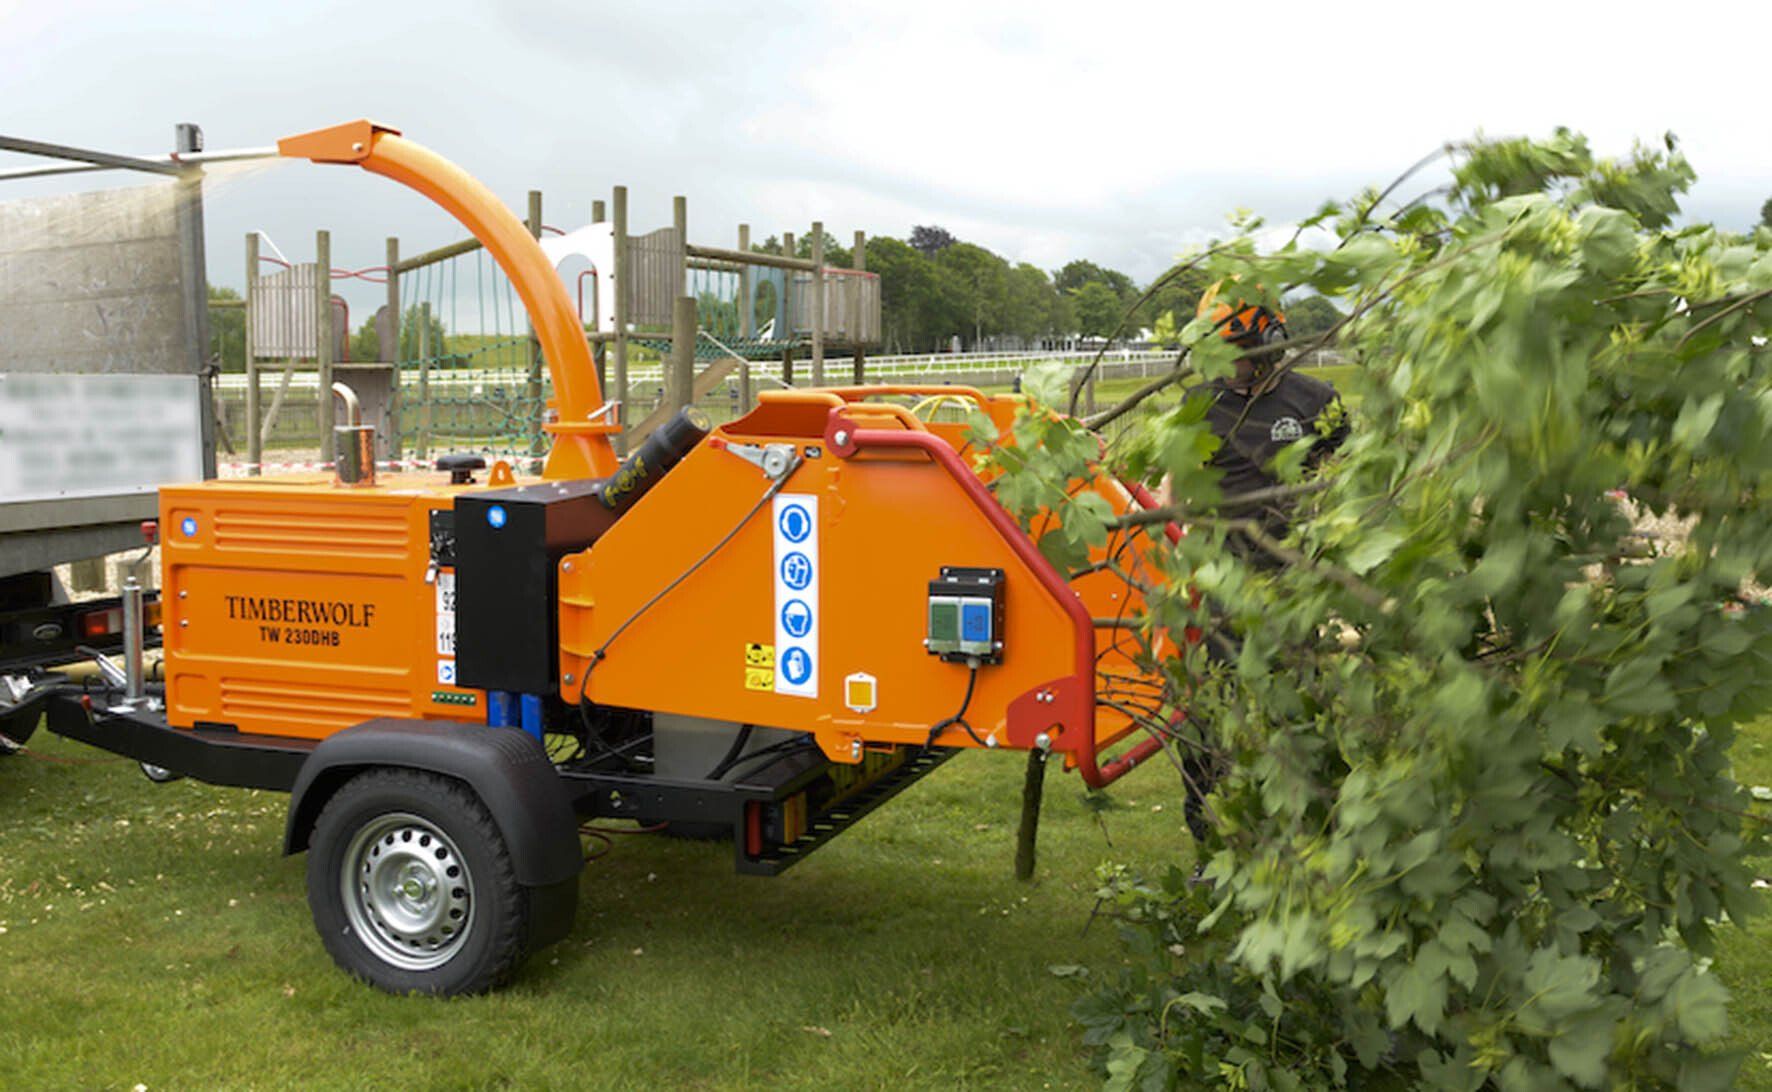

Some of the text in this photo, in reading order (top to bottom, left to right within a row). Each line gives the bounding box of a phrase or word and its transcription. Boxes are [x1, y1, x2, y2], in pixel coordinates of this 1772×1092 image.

[225, 595, 375, 627] TIMBERWOLF
[259, 626, 341, 646] TW 230DHB
